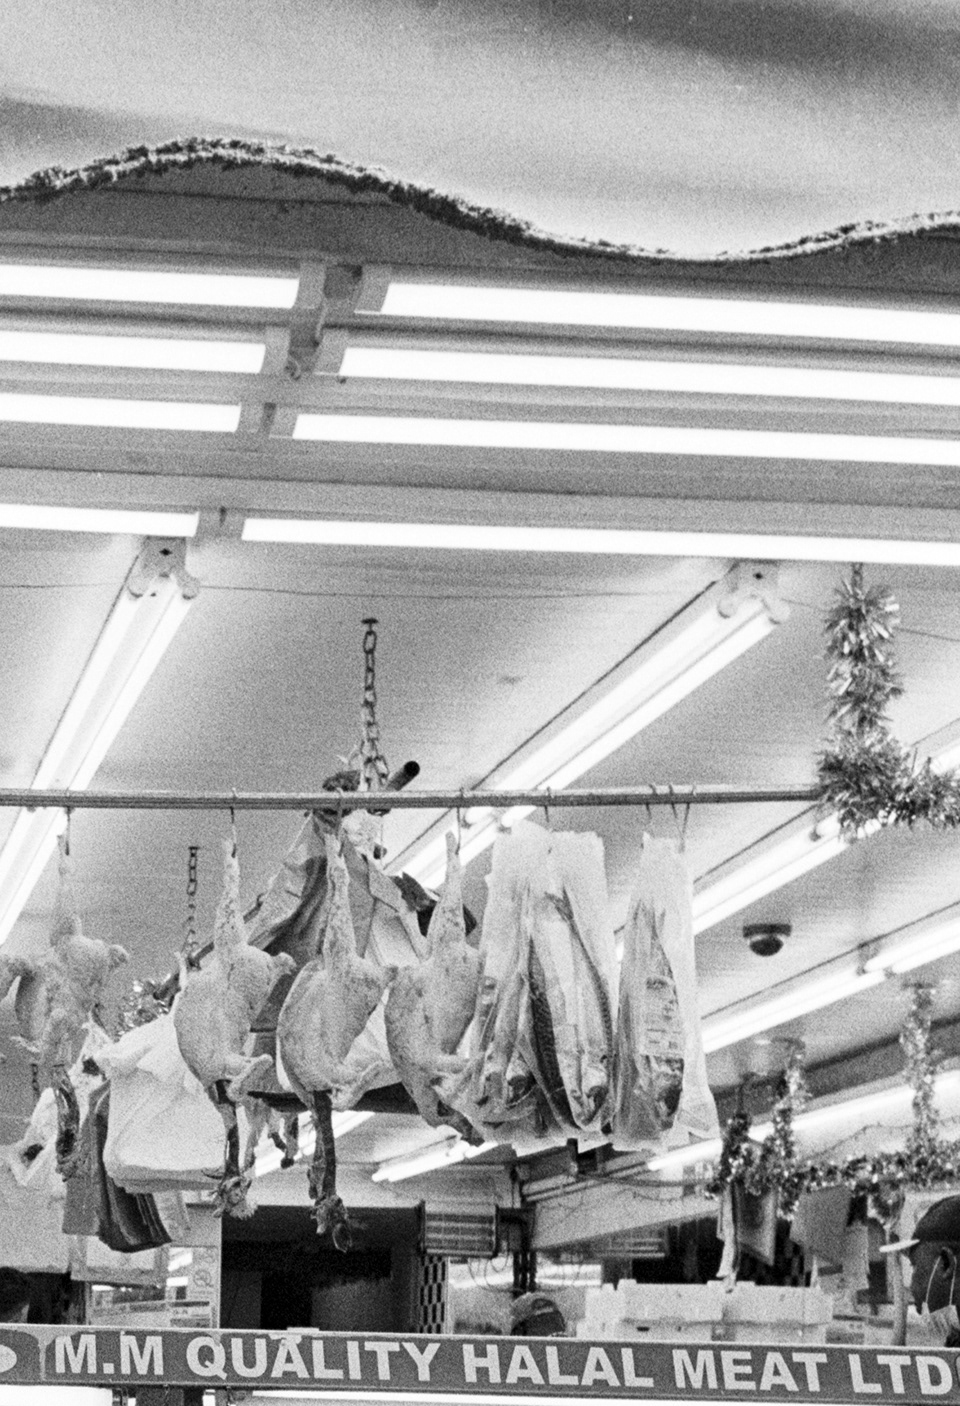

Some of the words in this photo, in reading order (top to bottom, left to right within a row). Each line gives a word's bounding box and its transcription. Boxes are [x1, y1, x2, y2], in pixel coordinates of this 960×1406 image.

[54, 1333, 164, 1375] M.M
[185, 1336, 441, 1382] QUALITY
[462, 1343, 654, 1388] HALAL
[671, 1348, 827, 1392] MEAT
[848, 1353, 953, 1395] LTD
